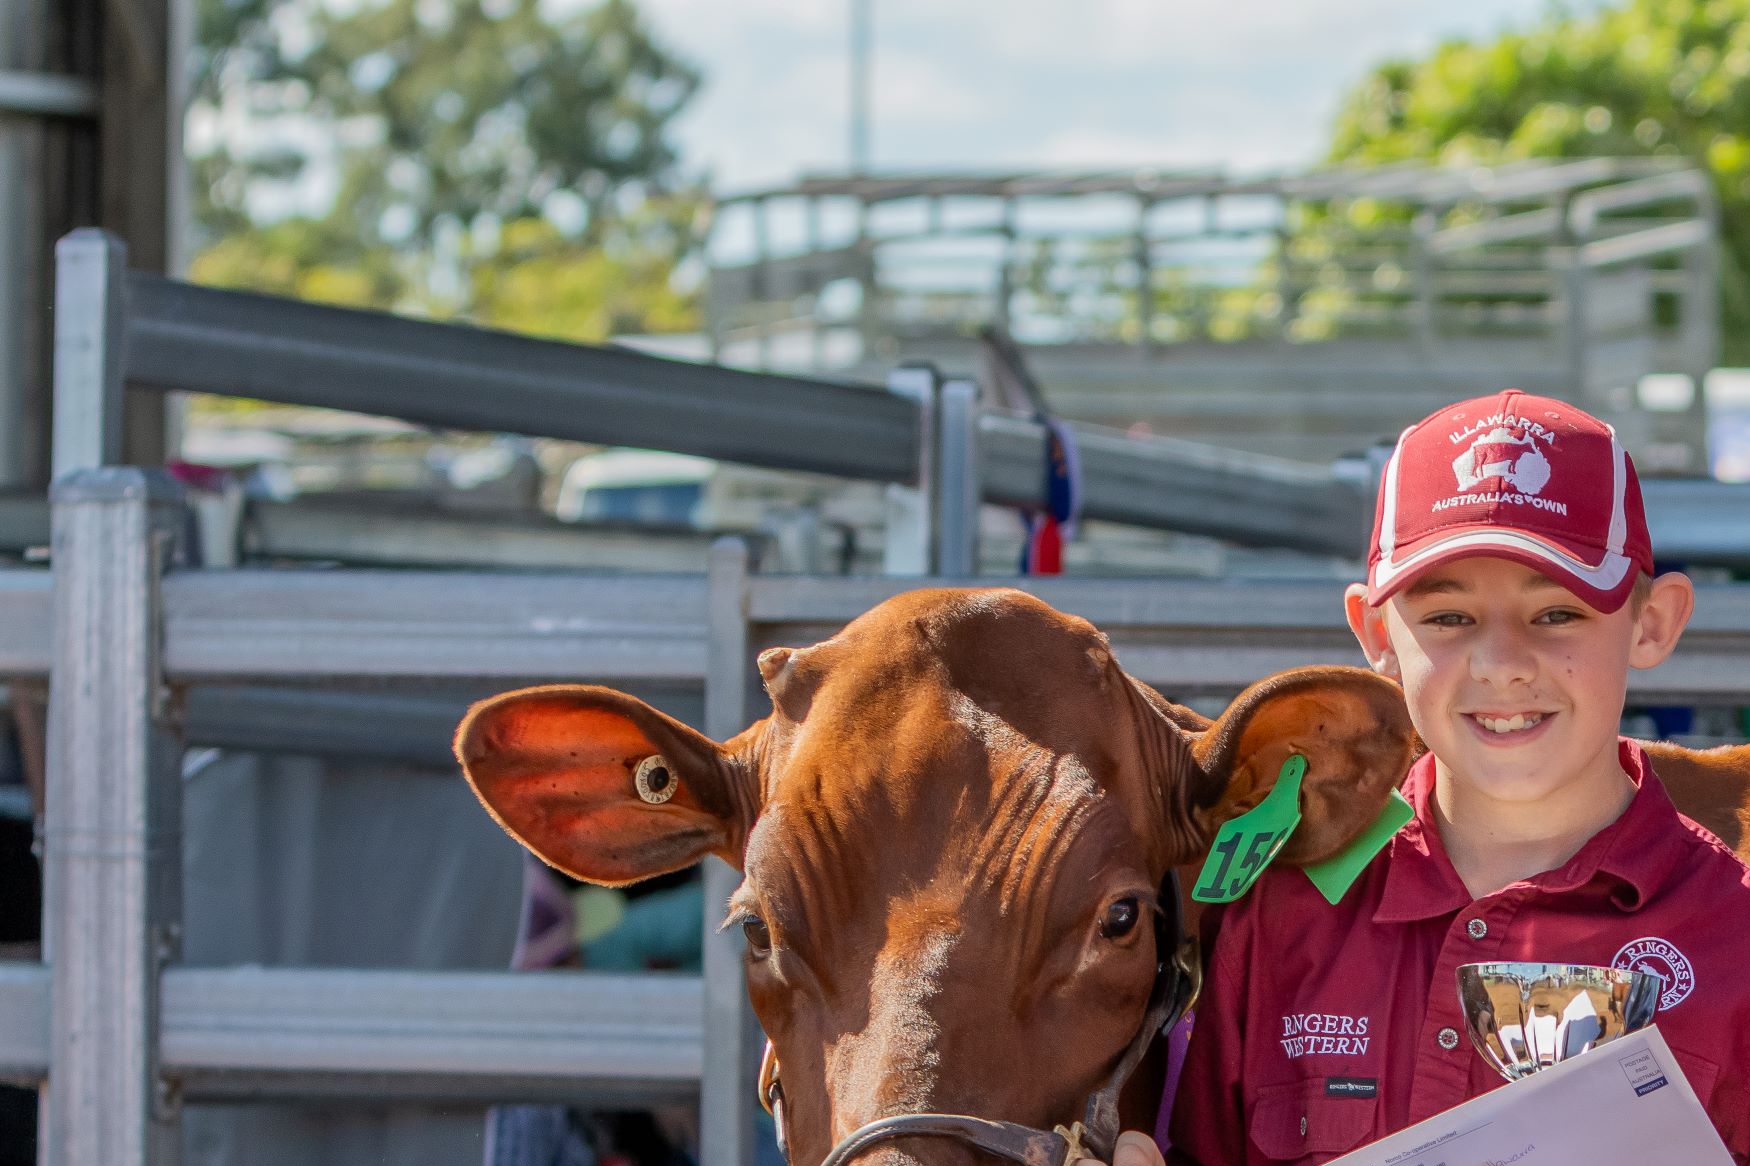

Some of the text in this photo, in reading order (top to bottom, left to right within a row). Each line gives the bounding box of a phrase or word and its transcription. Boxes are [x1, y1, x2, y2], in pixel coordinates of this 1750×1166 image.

[1449, 413, 1555, 445] ILLAWARRA
[1431, 491, 1567, 516] AUSTRALIA'S OWN
[1625, 941, 1690, 980] RINGERS
[1280, 1035, 1370, 1059] WESTERN
[1638, 1080, 1664, 1093] PRIORITY
